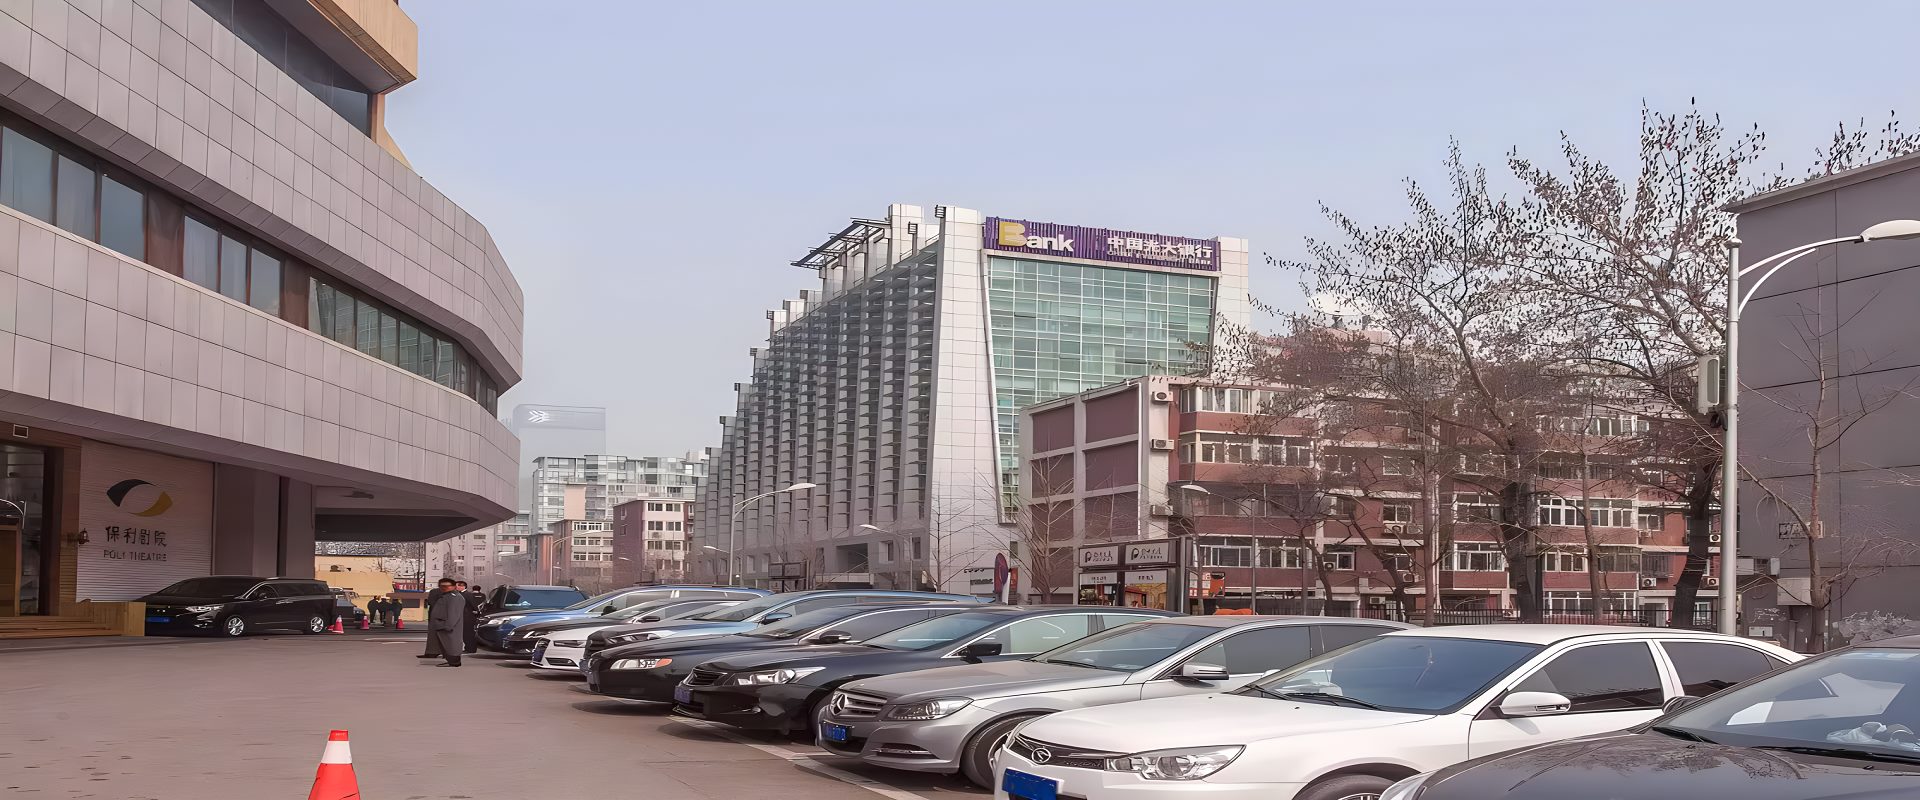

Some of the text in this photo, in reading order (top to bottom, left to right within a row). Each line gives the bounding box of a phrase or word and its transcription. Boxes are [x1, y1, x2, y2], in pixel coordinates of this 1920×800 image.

[999, 221, 1074, 252] Bank
[1107, 236, 1213, 259] 中国光大银行
[105, 526, 167, 547] 保利剧院
[103, 549, 167, 562] POLY THEATRE
